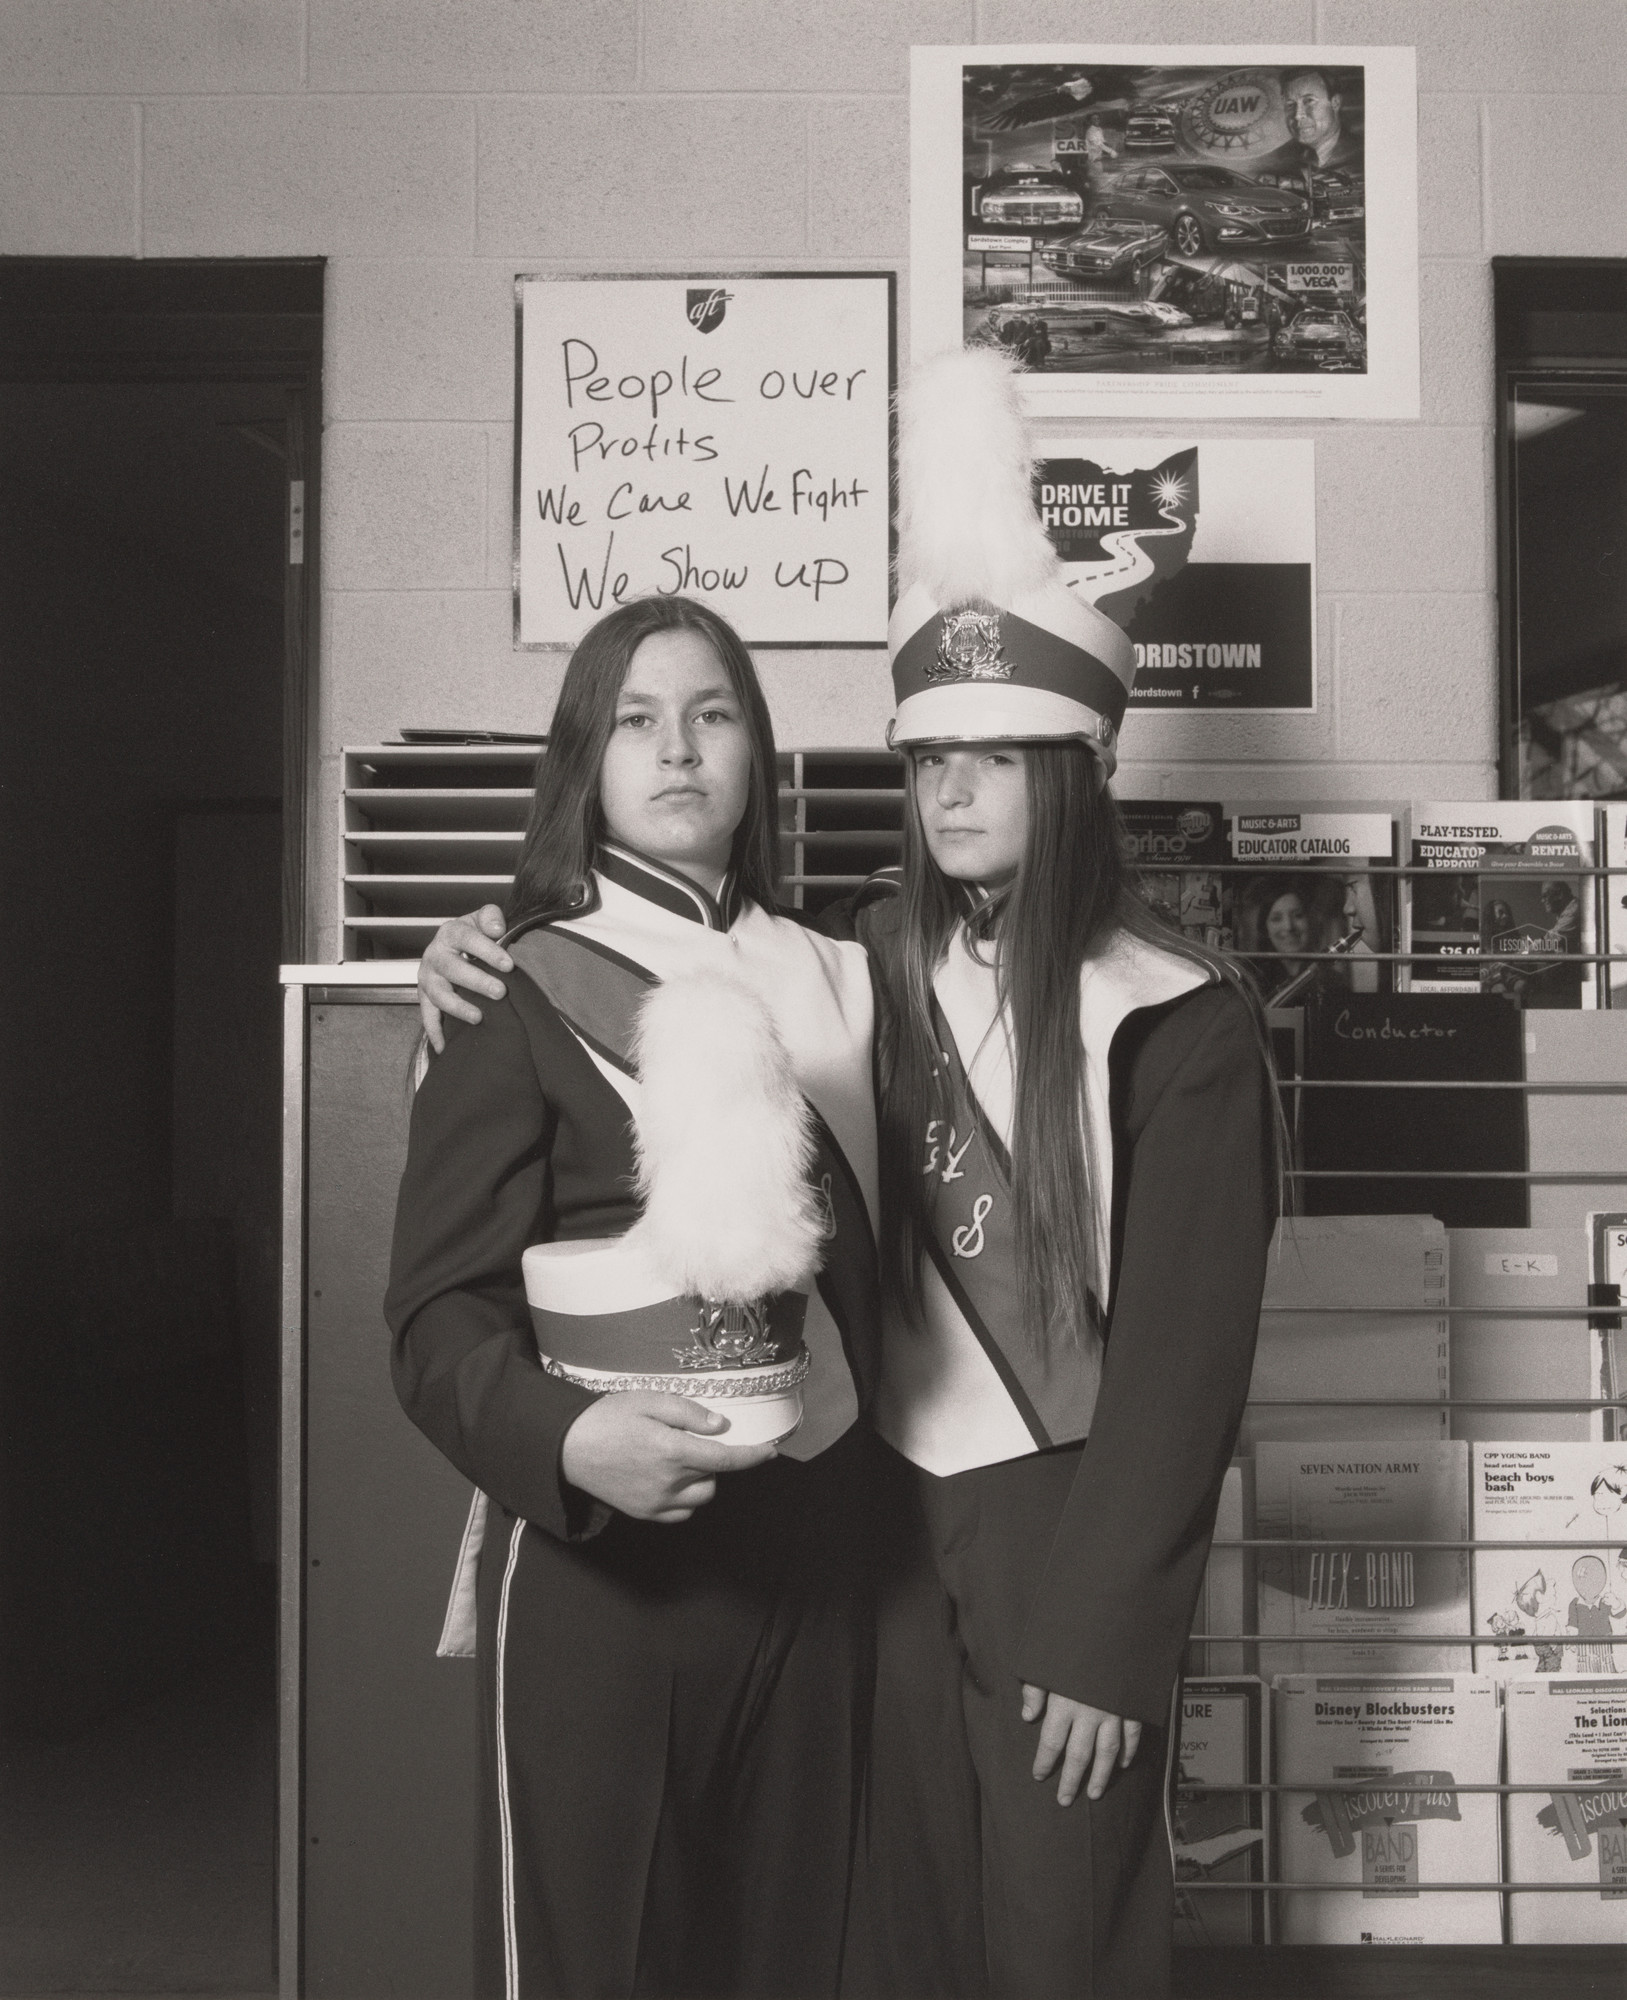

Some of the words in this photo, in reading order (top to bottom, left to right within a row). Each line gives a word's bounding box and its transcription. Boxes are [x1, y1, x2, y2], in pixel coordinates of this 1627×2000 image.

[1213, 95, 1261, 115] UAW
[1302, 276, 1338, 288] VEGA
[562, 339, 736, 419] People
[760, 369, 867, 401] over
[568, 422, 719, 473] Profits
[537, 485, 587, 526] We
[607, 482, 692, 520] Care
[724, 464, 781, 517] We
[1041, 484, 1105, 505] DRIVE
[1112, 484, 1132, 505] IT
[1041, 507, 1129, 527] HOME
[558, 531, 632, 610] We
[657, 544, 748, 595] Show
[1133, 643, 1261, 669] ORDSTOWN
[1241, 818, 1267, 829] MUSIC
[1277, 818, 1298, 829] ARTS
[1420, 825, 1502, 838] PLAY-TESTED.
[1237, 838, 1297, 855] EDUCATOR
[1300, 838, 1350, 855] CATALOG
[1420, 845, 1487, 859] EDUCATOR
[1531, 844, 1579, 856] RENTAL
[1334, 1008, 1457, 1040] Conductor
[1300, 1463, 1334, 1475] SEVEN
[1336, 1463, 1382, 1475] NATION
[1385, 1462, 1420, 1474] ARMY
[1485, 1471, 1521, 1482] beach
[1525, 1471, 1554, 1484] boys
[1485, 1481, 1514, 1492] bash
[1183, 1703, 1212, 1718] URE
[1315, 1702, 1361, 1719] Disney
[1366, 1702, 1455, 1715] Blockbusters
[1590, 1706, 1626, 1714] Selections
[1574, 1715, 1598, 1728] The
[1365, 1832, 1414, 1863] BAND
